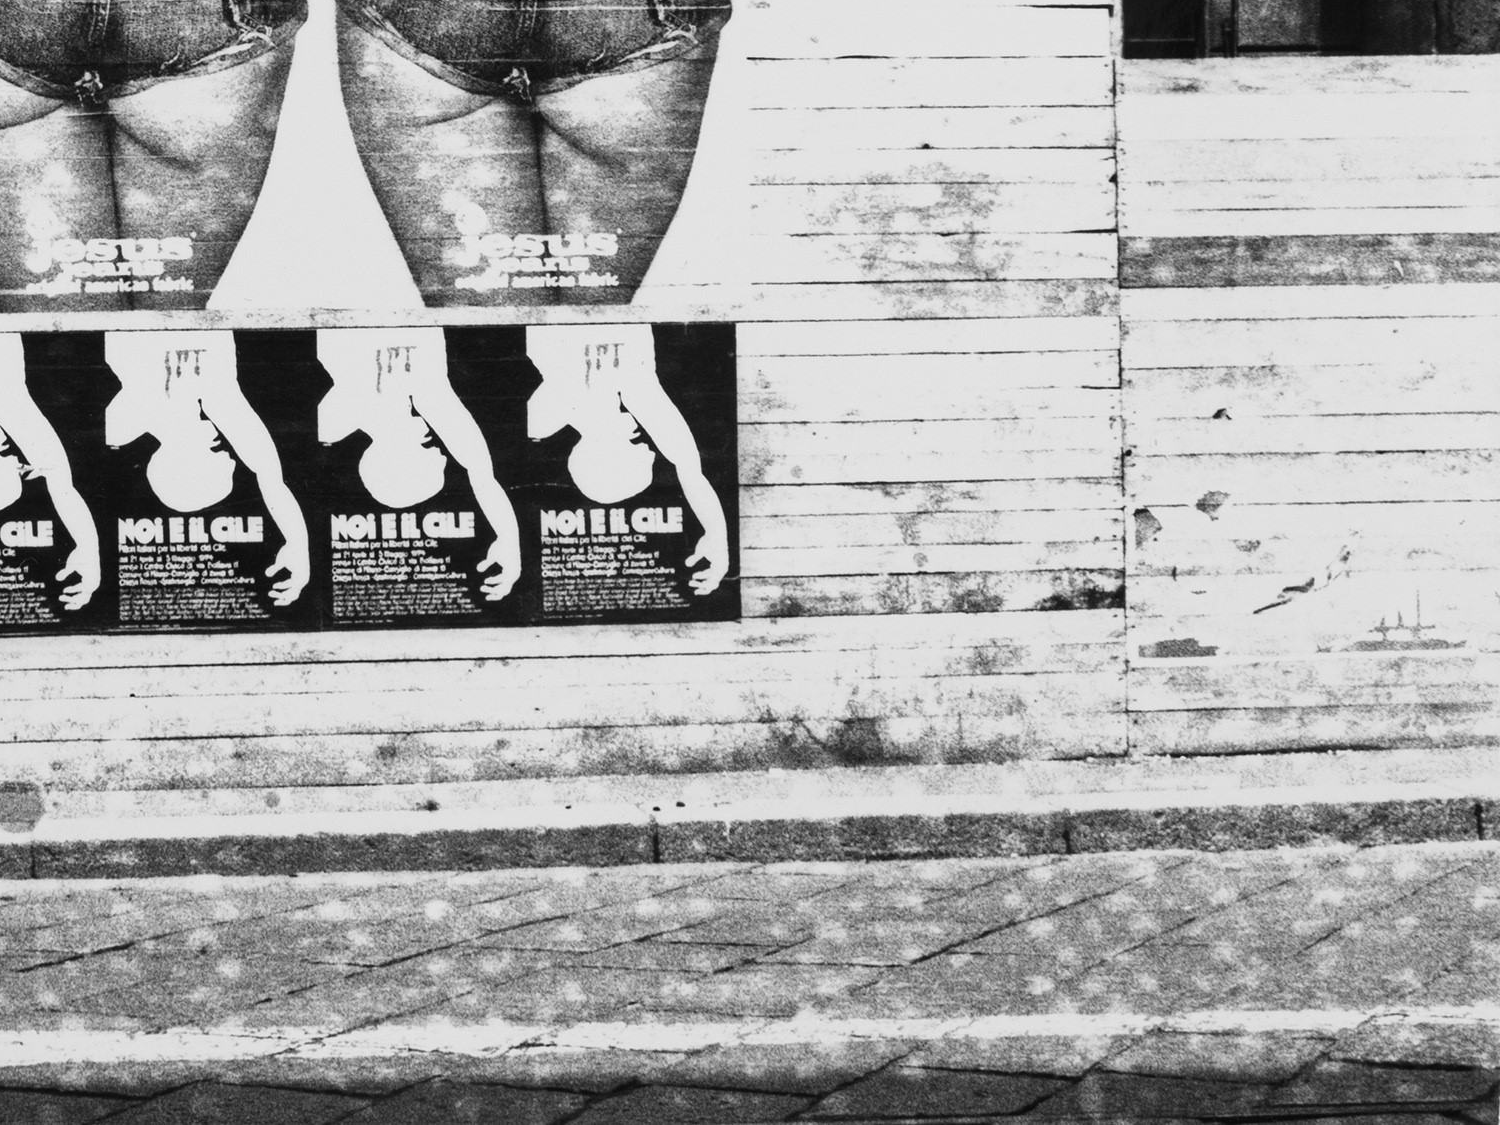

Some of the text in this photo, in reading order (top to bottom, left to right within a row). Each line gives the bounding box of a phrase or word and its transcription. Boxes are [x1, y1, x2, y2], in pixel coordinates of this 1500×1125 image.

[169, 517, 185, 543] E
[381, 513, 397, 539] E
[590, 509, 606, 534] E
